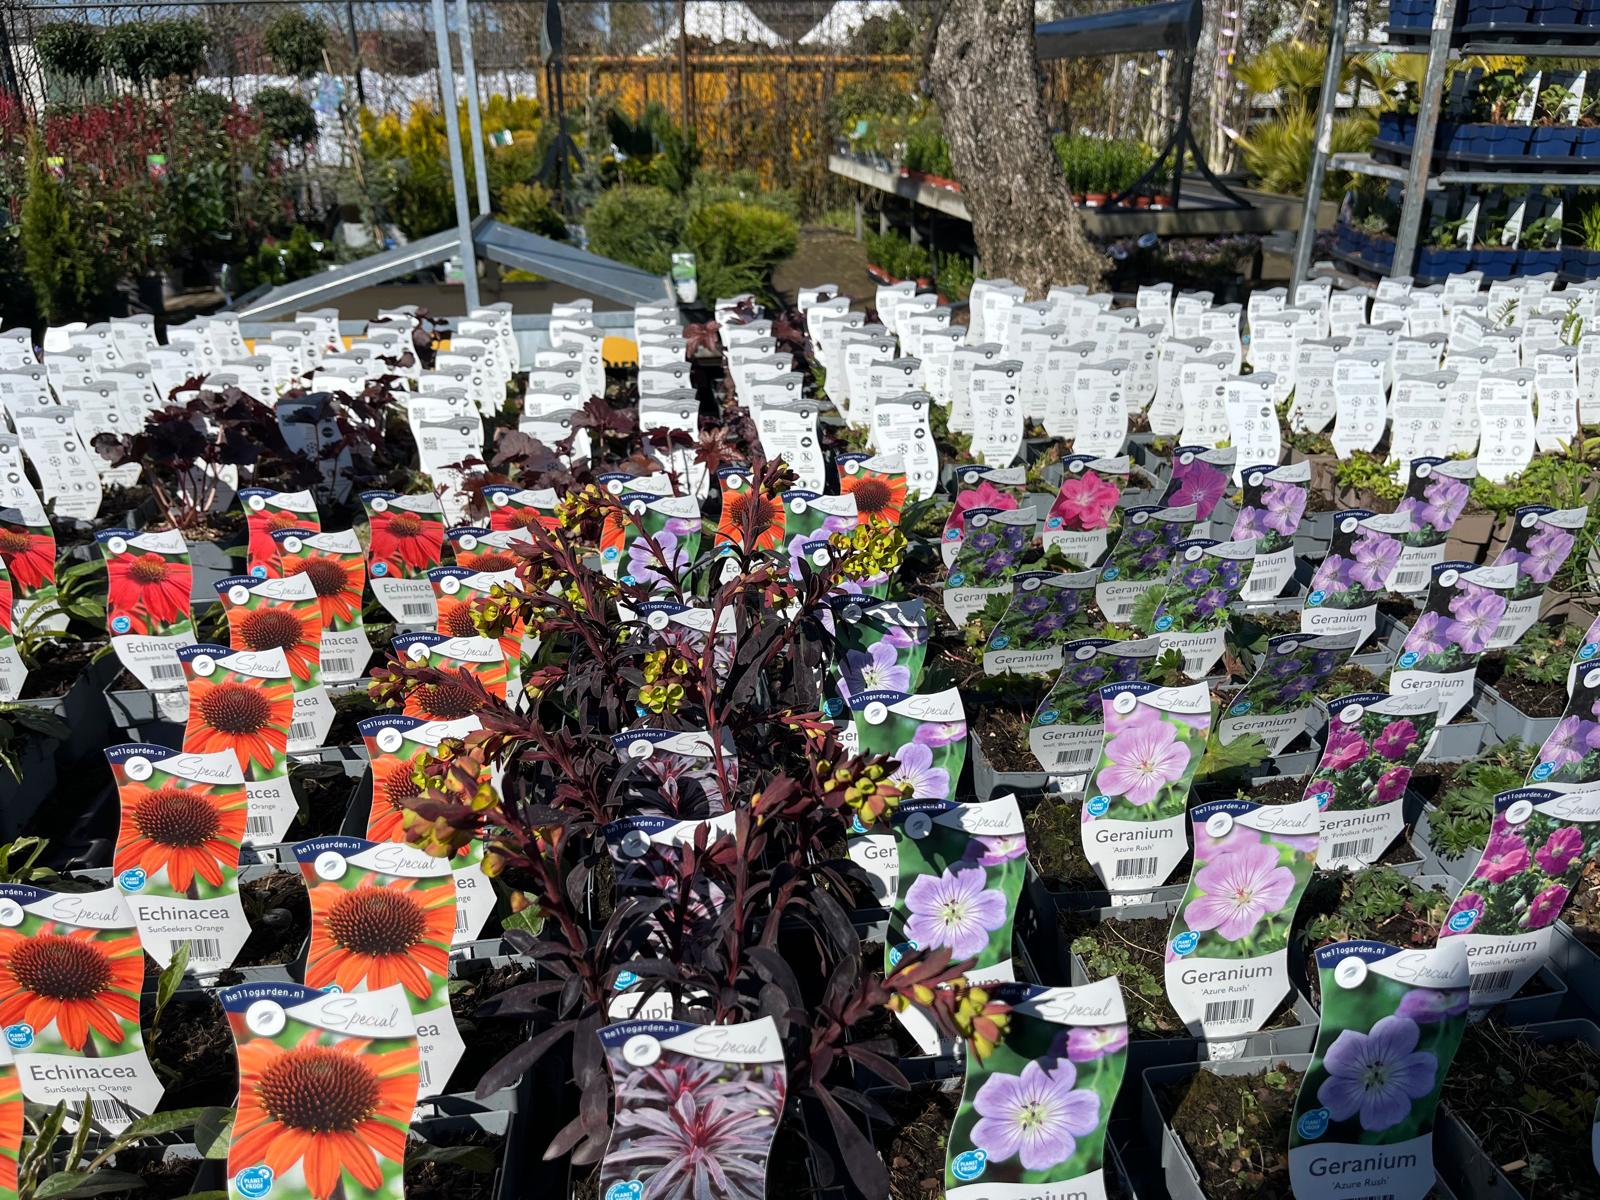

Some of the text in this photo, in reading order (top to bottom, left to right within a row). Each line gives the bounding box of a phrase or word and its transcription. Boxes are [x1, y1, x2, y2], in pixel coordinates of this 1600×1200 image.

[1052, 535, 1099, 544] Geranium
[1255, 556, 1287, 568] ranium
[1401, 549, 1437, 561] ranium
[384, 583, 431, 593] Echinace
[1106, 584, 1150, 595] Geraniu
[1310, 613, 1367, 625] Geranium
[449, 638, 494, 658] Special
[1159, 635, 1217, 649] Geranium
[234, 654, 281, 673] Special
[994, 653, 1054, 664] Geranium
[1103, 684, 1151, 694] hellogarden.nl
[1401, 677, 1465, 690] Geranium
[851, 693, 900, 705] hellogarden.nl
[1155, 690, 1200, 709] Special
[1384, 696, 1432, 713] Special
[907, 699, 955, 717] Special
[362, 719, 415, 730] hellogarden.nl
[1232, 717, 1297, 731] Geranium
[615, 731, 667, 743] hellogarden.nl
[109, 747, 166, 758] hellogarden.nl
[177, 757, 232, 779] Special
[1498, 792, 1552, 803] hellogarden.nl
[1194, 803, 1250, 816] hellogarden.nl
[1553, 797, 1600, 817] Specia
[961, 806, 1013, 831] Special
[1256, 807, 1312, 829] Special
[1096, 826, 1173, 844] Geranium
[297, 841, 361, 855] hellogarden.nl
[1112, 843, 1155, 854] 'Azure Rush'
[374, 845, 436, 871] Special
[0, 888, 38, 898] arden.nl
[52, 897, 119, 924] Special
[138, 904, 230, 922] Echinacea
[147, 924, 225, 934] SunSeekers Orange
[1321, 945, 1386, 960] hellogarden.nl
[1466, 940, 1538, 958] eranium
[1394, 953, 1456, 982] Special
[1181, 965, 1273, 986] Geranium
[225, 984, 305, 1003] hellogarden.nl
[1201, 984, 1251, 997] 'Azure Rush'
[1043, 991, 1112, 1017] Special
[321, 997, 398, 1032] Special
[603, 1024, 680, 1040] hellogarden.nl
[693, 1029, 767, 1059] Special
[29, 1064, 138, 1083] Echinacea
[44, 1082, 134, 1095] SunSeekers Orange
[1308, 1152, 1418, 1177] Geranium
[243, 1177, 264, 1185] PLANET
[1331, 1175, 1391, 1191] 'Azure Rush'
